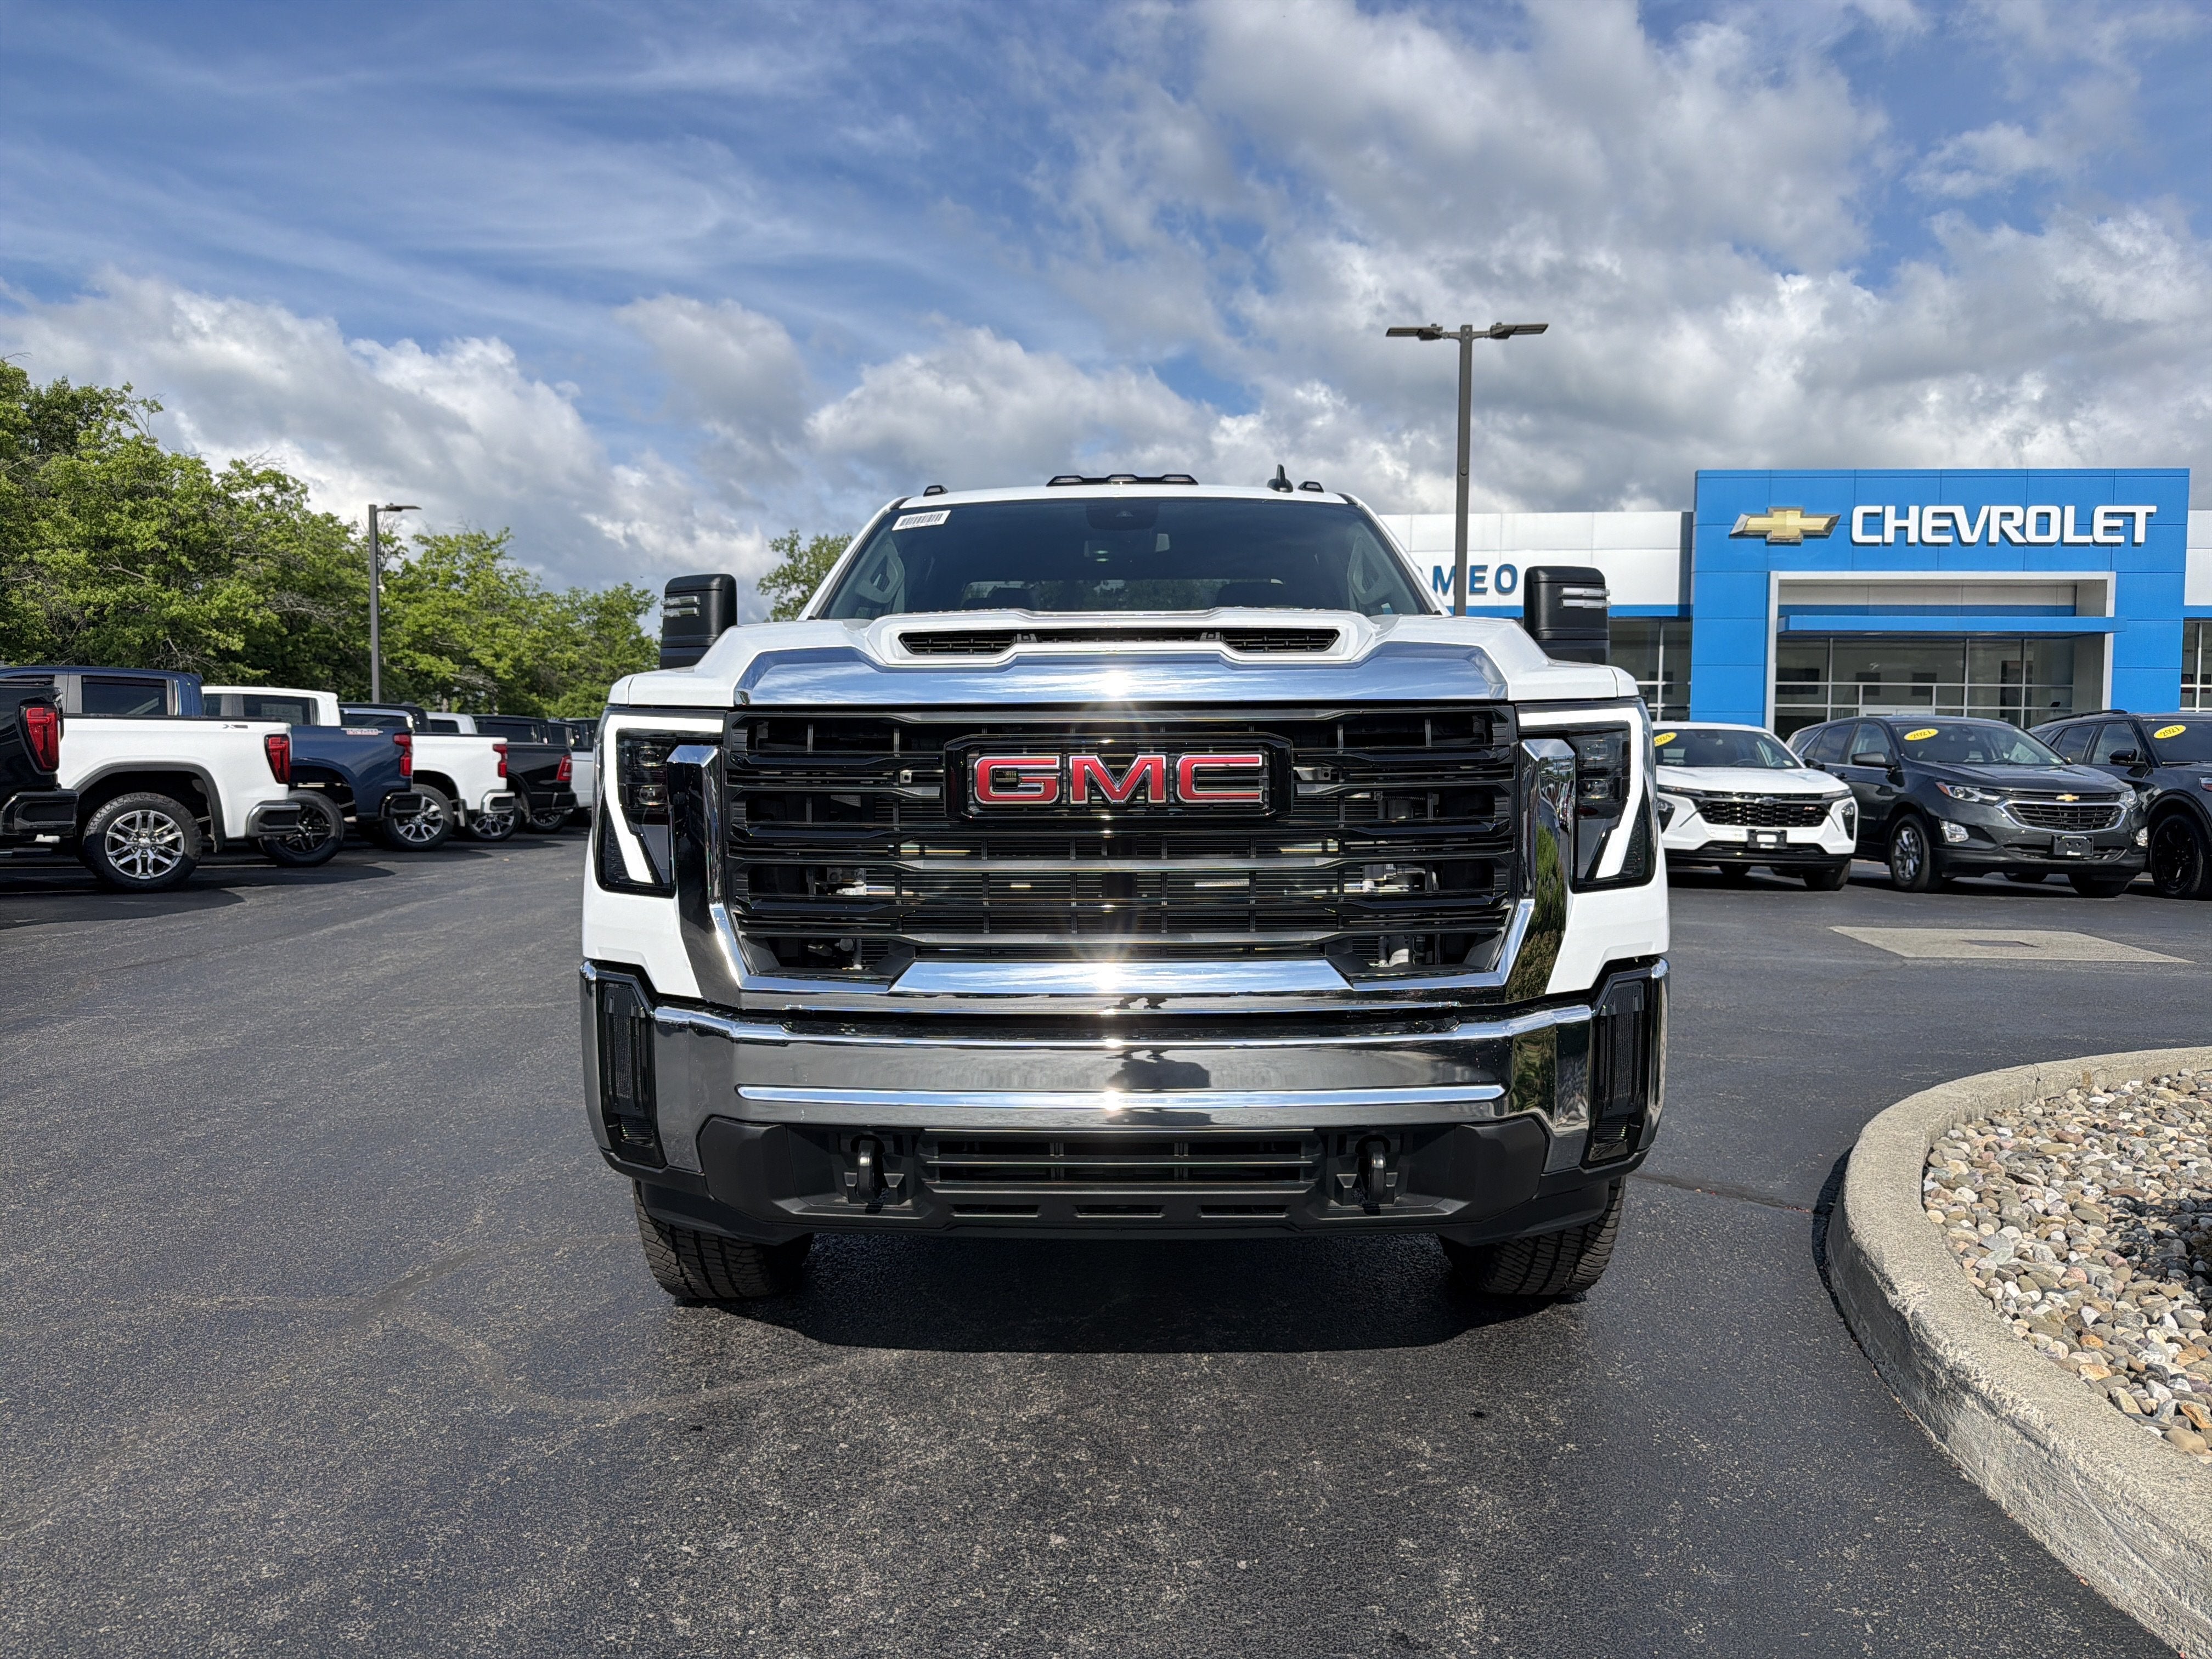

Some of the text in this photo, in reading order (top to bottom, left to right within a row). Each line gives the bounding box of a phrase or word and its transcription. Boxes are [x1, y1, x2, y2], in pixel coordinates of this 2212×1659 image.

[1851, 505, 2157, 545] CHEVROLET
[1418, 563, 1518, 596] MEO
[2160, 726, 2181, 736] 2021
[974, 753, 1265, 805] GMC
